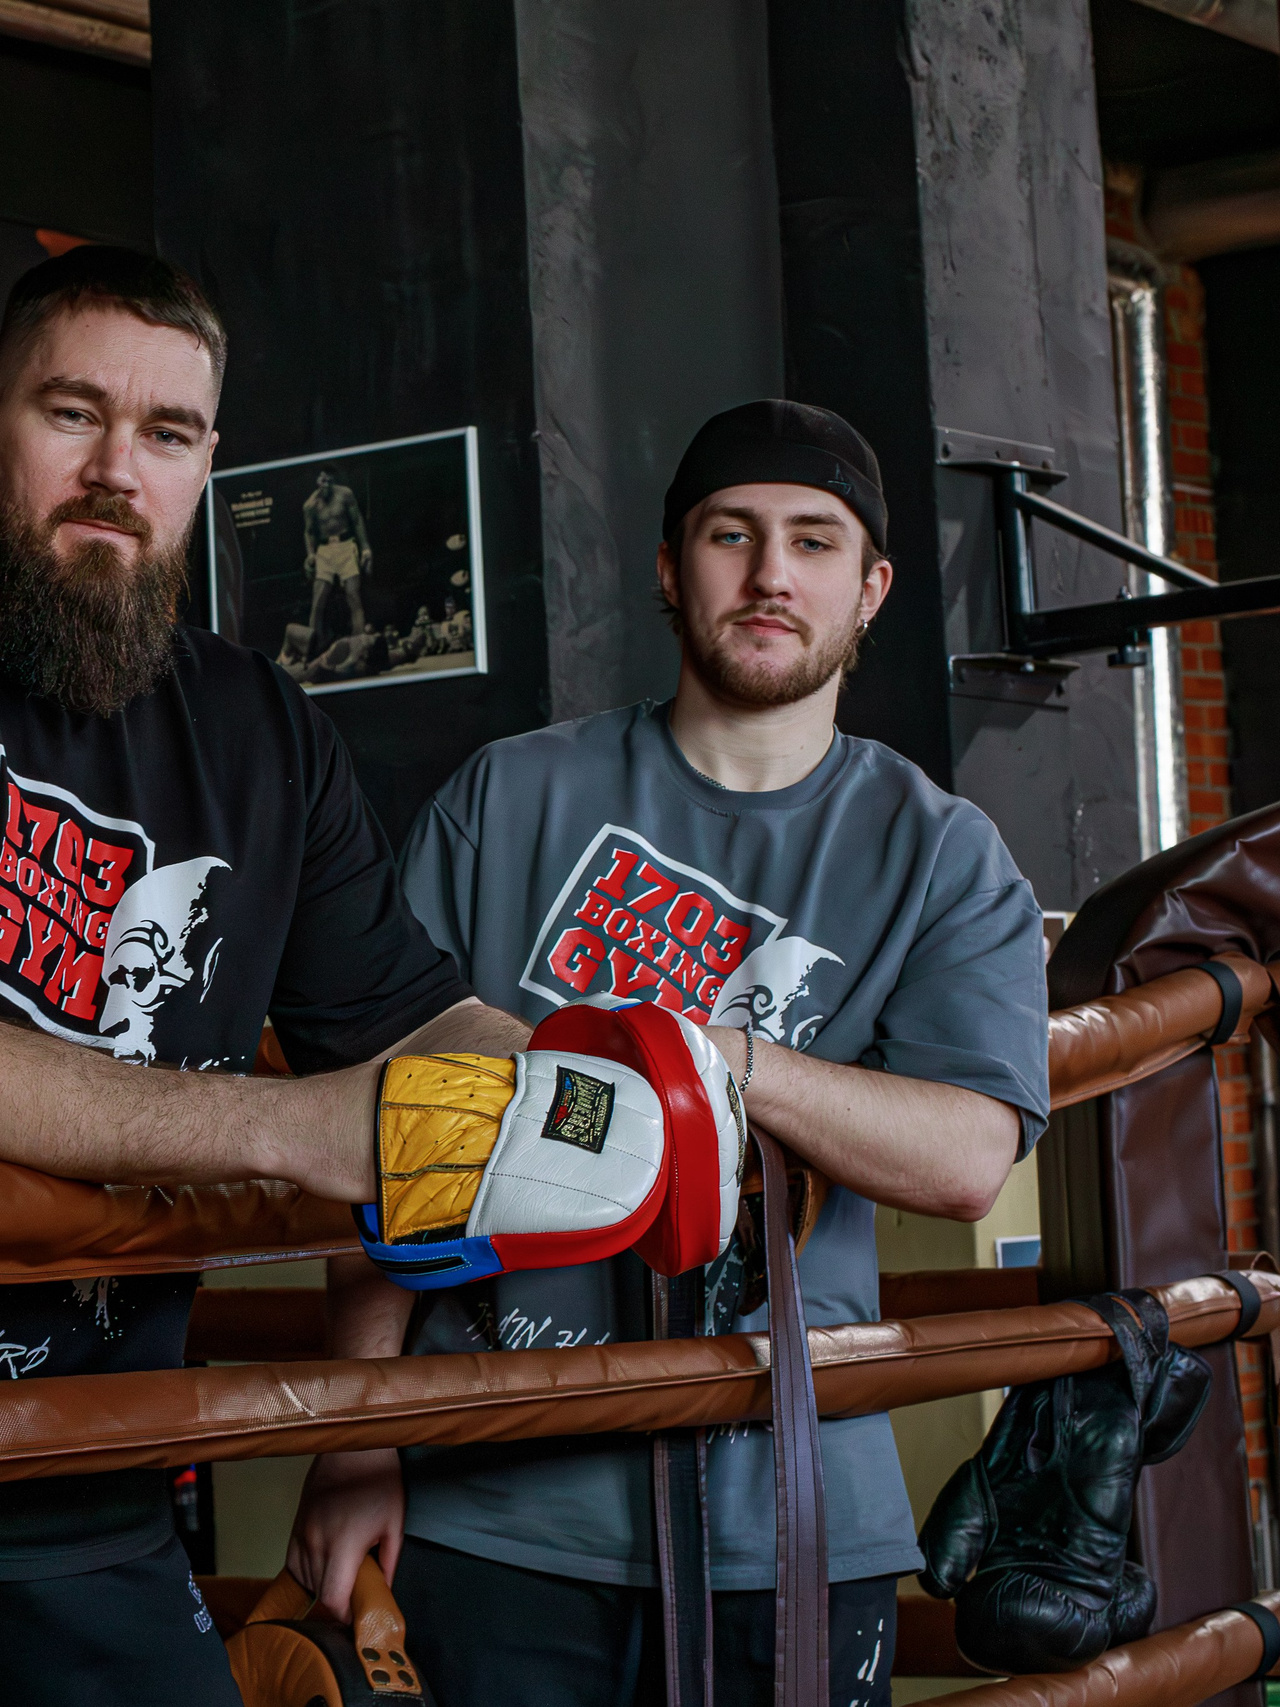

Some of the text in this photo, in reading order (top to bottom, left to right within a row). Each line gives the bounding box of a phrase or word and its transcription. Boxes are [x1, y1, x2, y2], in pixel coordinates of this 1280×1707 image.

[6, 782, 134, 908] 1703
[574, 889, 726, 1008] BOXING
[592, 847, 751, 976] 1703
